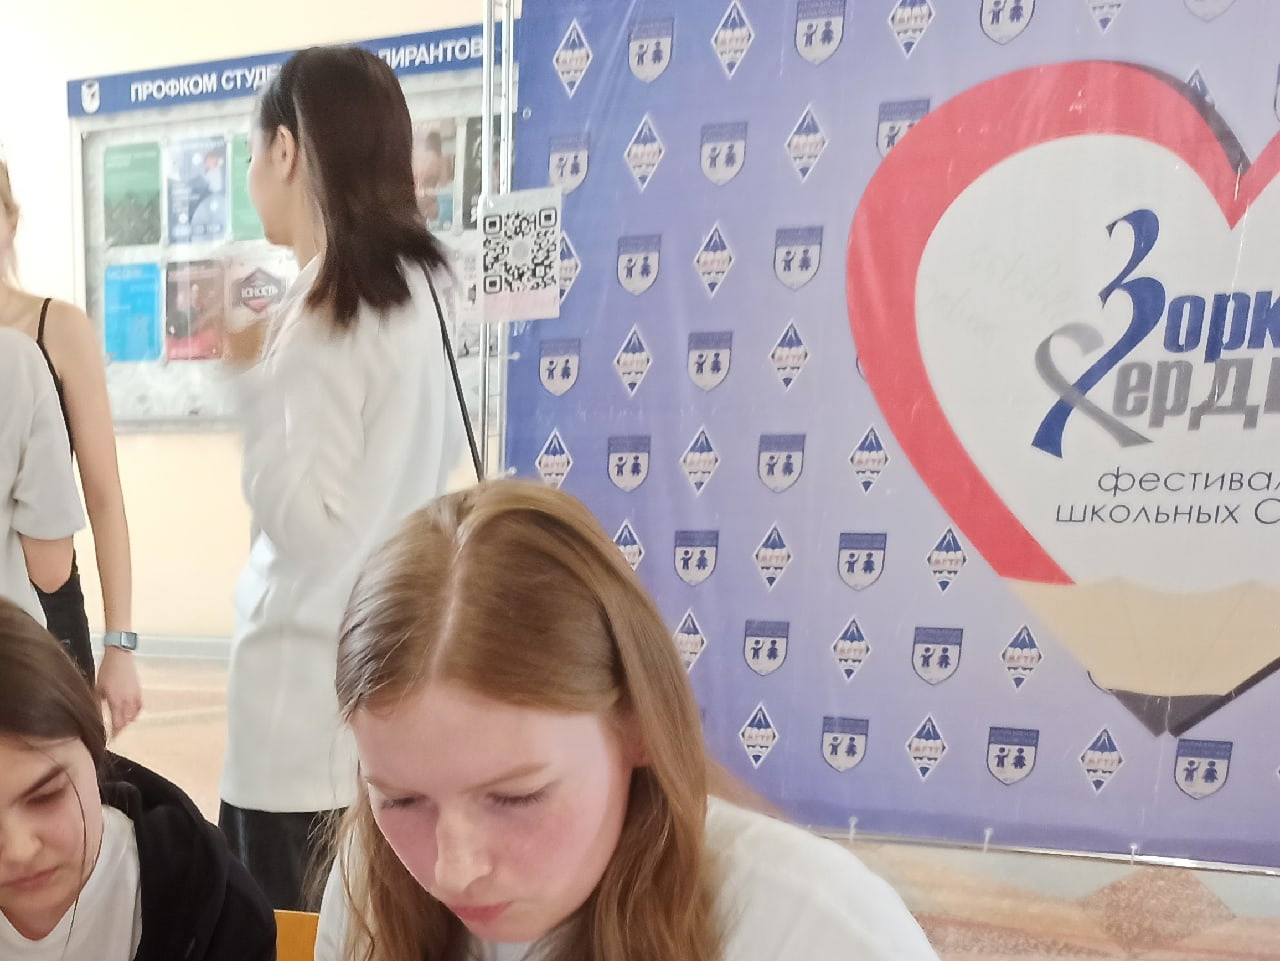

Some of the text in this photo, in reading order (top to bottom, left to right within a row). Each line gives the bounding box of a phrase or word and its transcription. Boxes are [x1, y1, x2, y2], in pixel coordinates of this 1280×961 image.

[131, 72, 217, 103] ПРОФКОМ
[377, 36, 483, 69] ПИРАНТОВ
[1055, 503, 1241, 525] школьных
